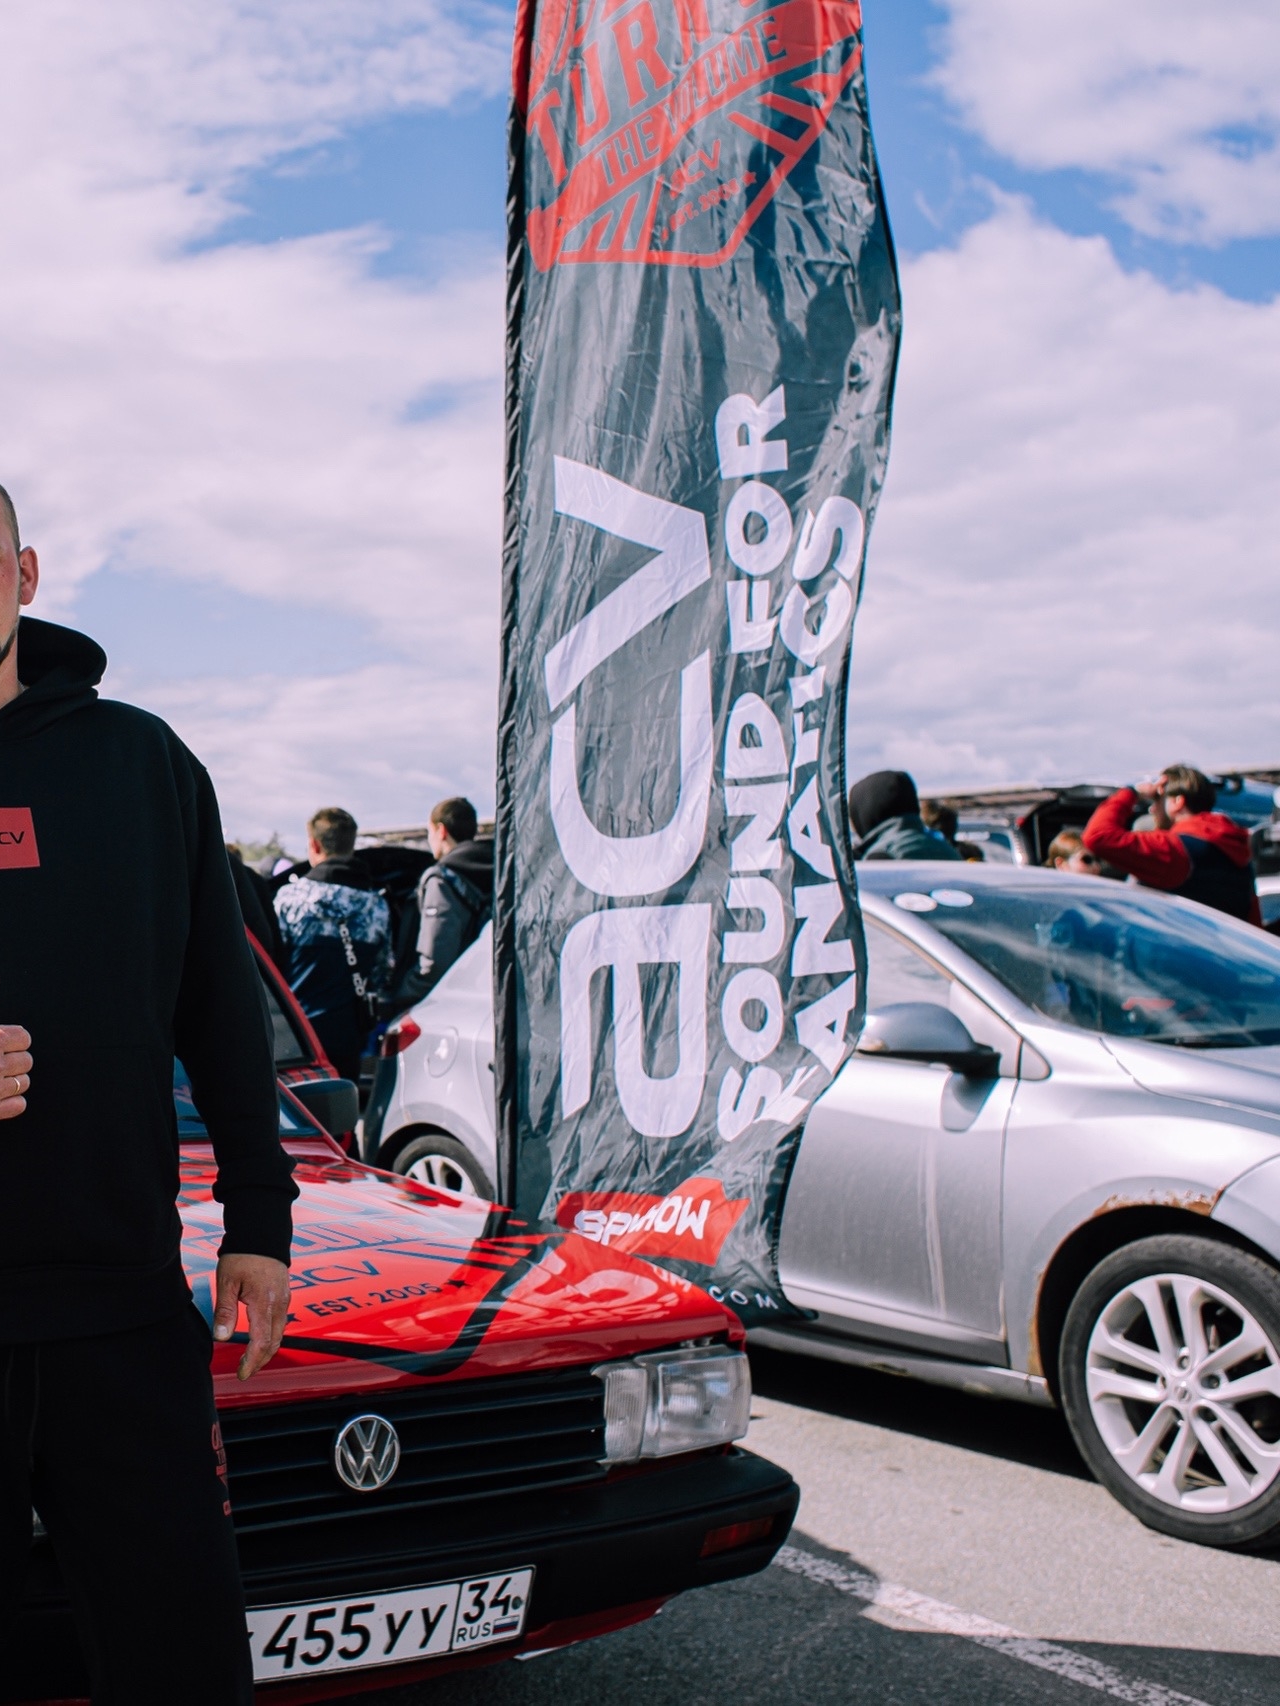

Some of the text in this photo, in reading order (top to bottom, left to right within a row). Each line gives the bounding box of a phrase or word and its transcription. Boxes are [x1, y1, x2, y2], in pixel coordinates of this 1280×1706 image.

[593, 113, 663, 186] THE
[715, 383, 789, 1142] SOUND FOR
[752, 495, 865, 1125] FANATICS
[305, 1282, 443, 1318] EST. 2005
[462, 1576, 513, 1625] 34
[456, 1622, 492, 1643] RUS
